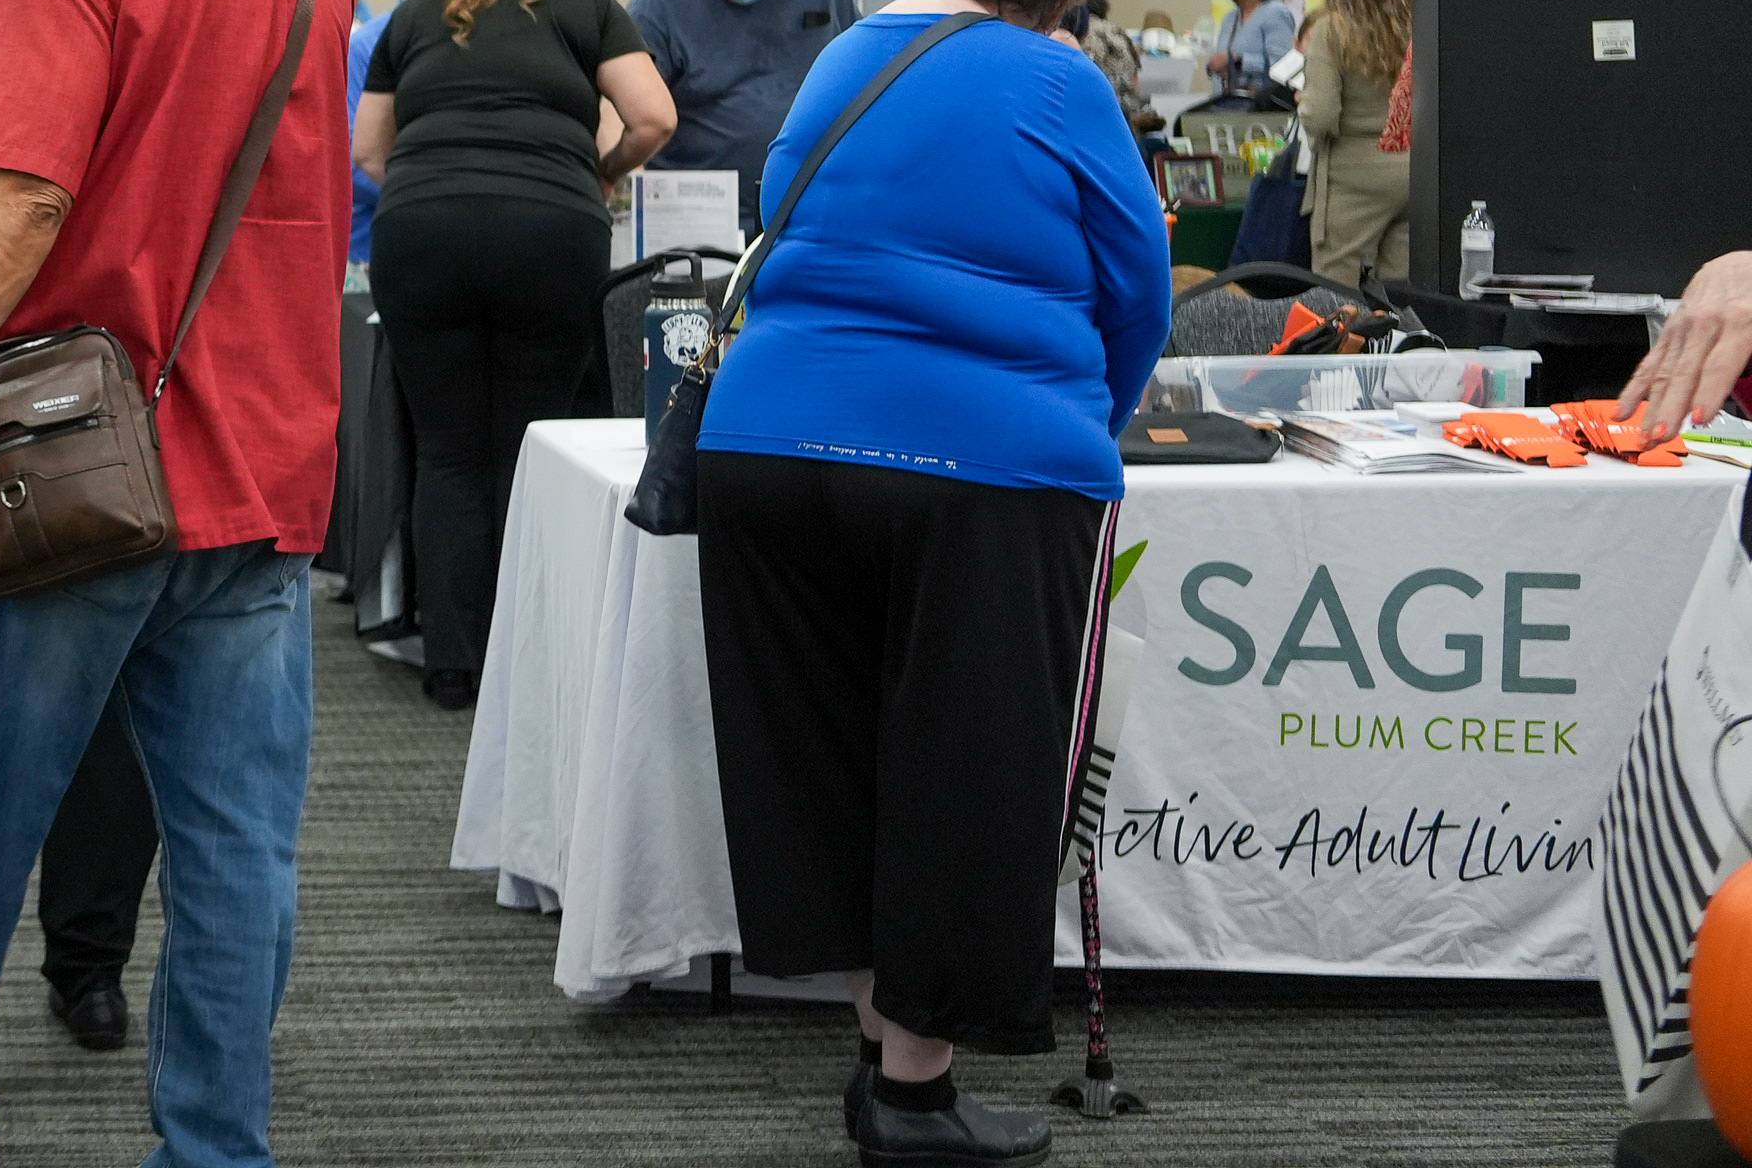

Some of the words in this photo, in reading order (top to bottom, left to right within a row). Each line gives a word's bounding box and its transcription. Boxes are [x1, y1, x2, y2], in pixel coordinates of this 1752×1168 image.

[862, 449, 880, 458] your
[886, 452, 895, 461] in
[914, 455, 939, 465] world
[945, 460, 958, 470] The
[1177, 561, 1581, 694] SAGE
[1280, 713, 1404, 750] PLUM
[1424, 718, 1578, 755] CREEK
[1275, 804, 1461, 879] Adult
[1459, 801, 1594, 881] Livin
